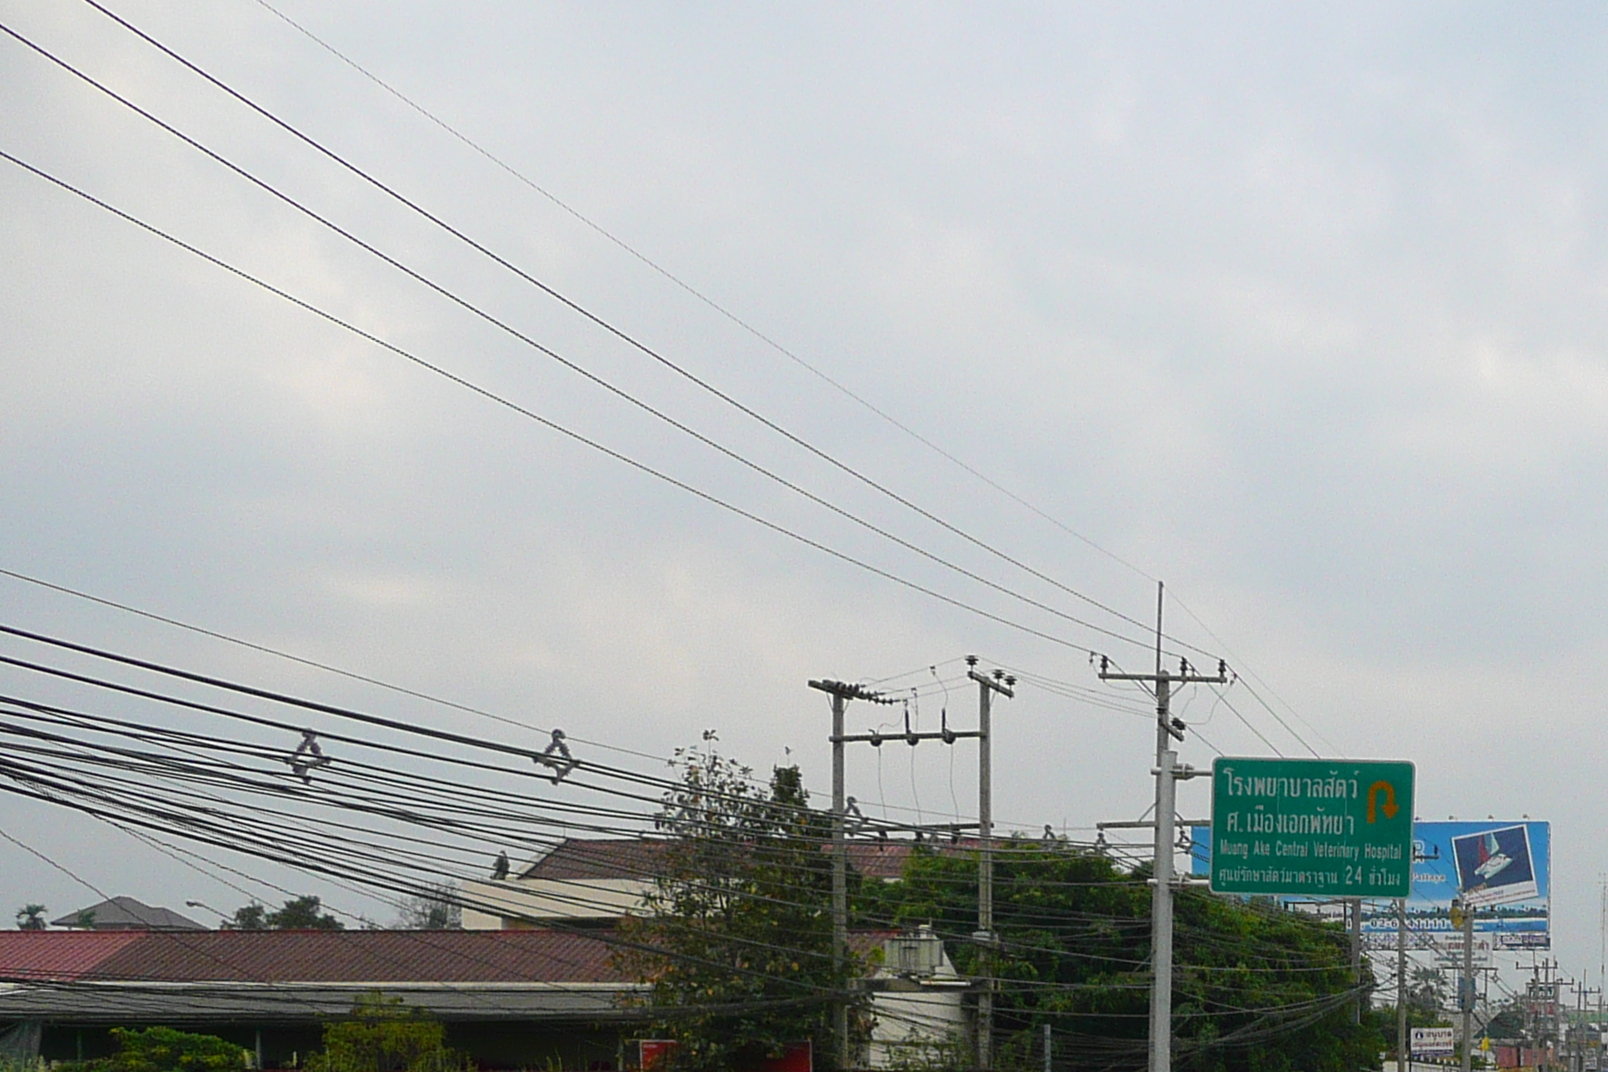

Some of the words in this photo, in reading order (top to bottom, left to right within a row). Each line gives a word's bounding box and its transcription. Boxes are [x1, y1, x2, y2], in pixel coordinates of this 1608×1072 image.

[1223, 766, 1360, 799] โรงพยาบาลสัตว์
[1220, 838, 1248, 859] Muang
[1253, 841, 1271, 857] Ake
[1275, 839, 1309, 858] Central
[1313, 841, 1360, 862] Veterinary
[1364, 842, 1402, 863] Hospital
[1345, 865, 1363, 886] 24
[1368, 866, 1401, 887] ชั่วโมง
